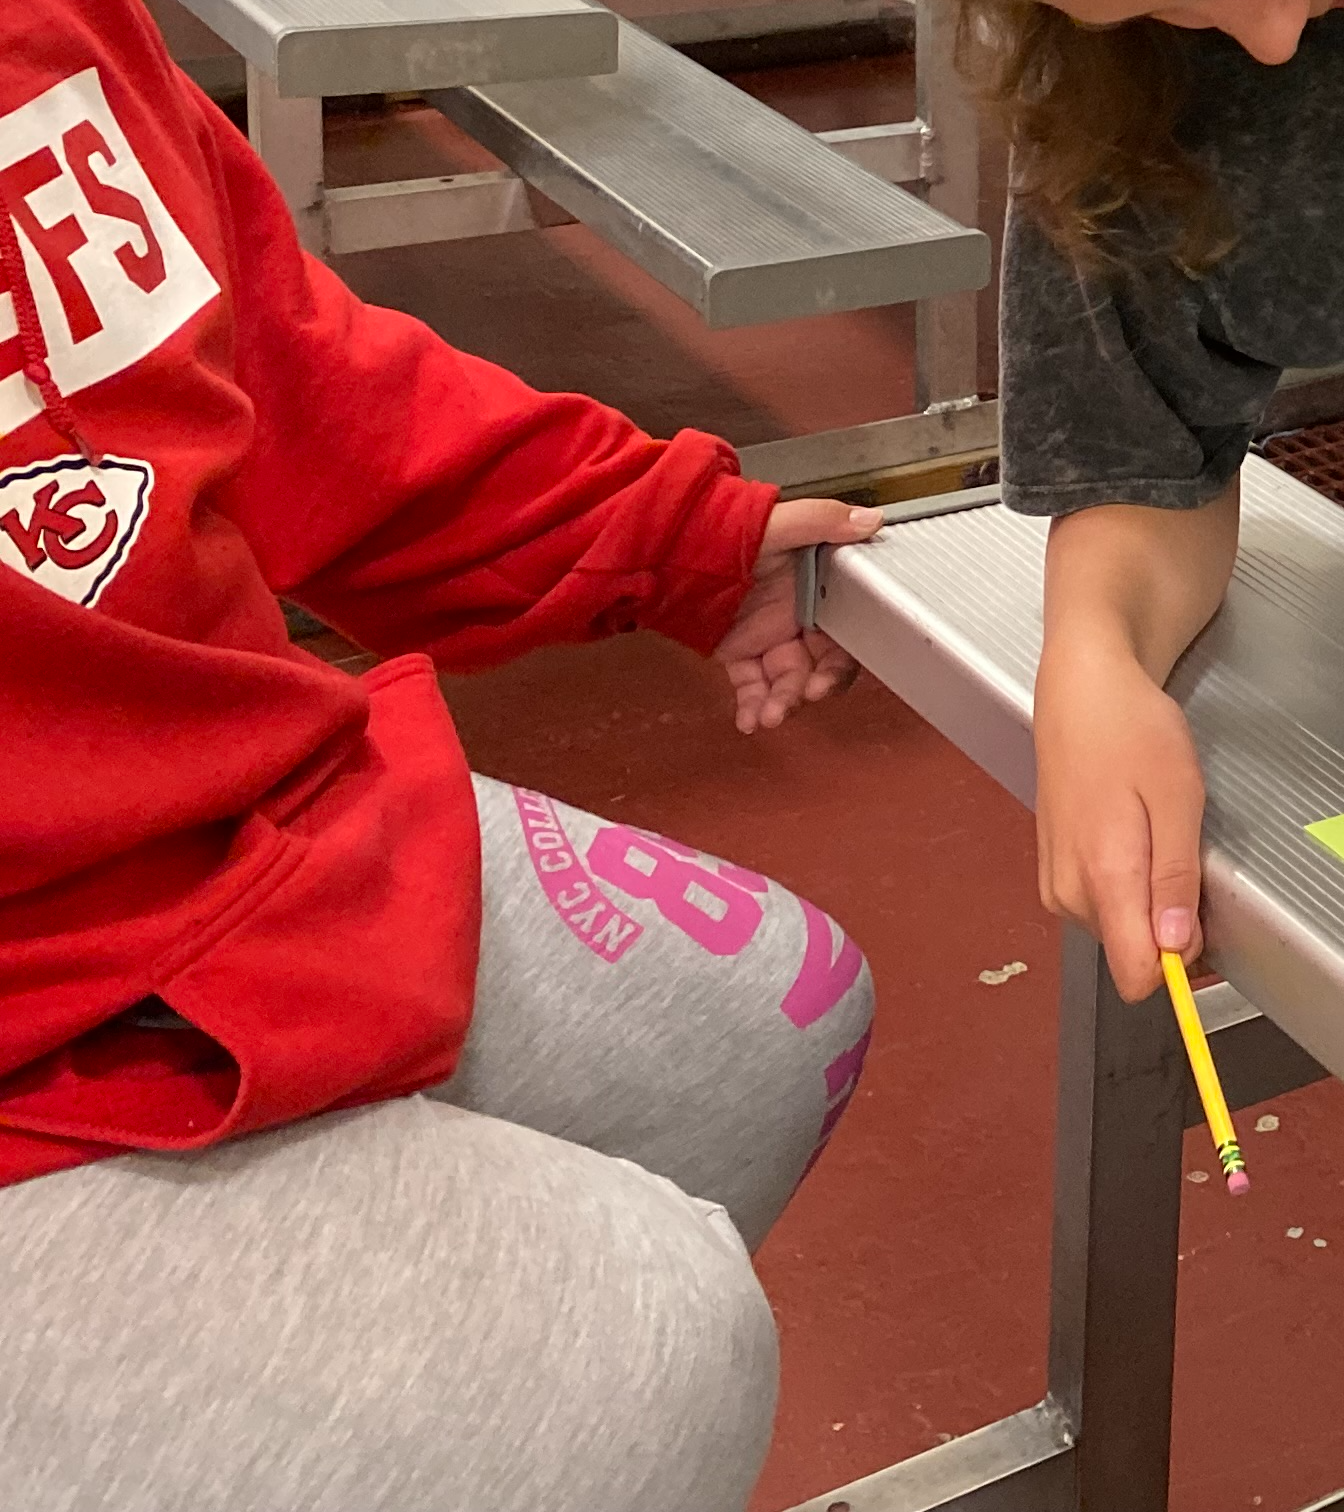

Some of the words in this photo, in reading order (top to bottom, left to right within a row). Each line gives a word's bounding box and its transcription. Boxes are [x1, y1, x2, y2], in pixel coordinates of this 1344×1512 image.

[0, 119, 167, 378] FS
[0, 479, 118, 571] KC
[556, 881, 635, 953] NYC
